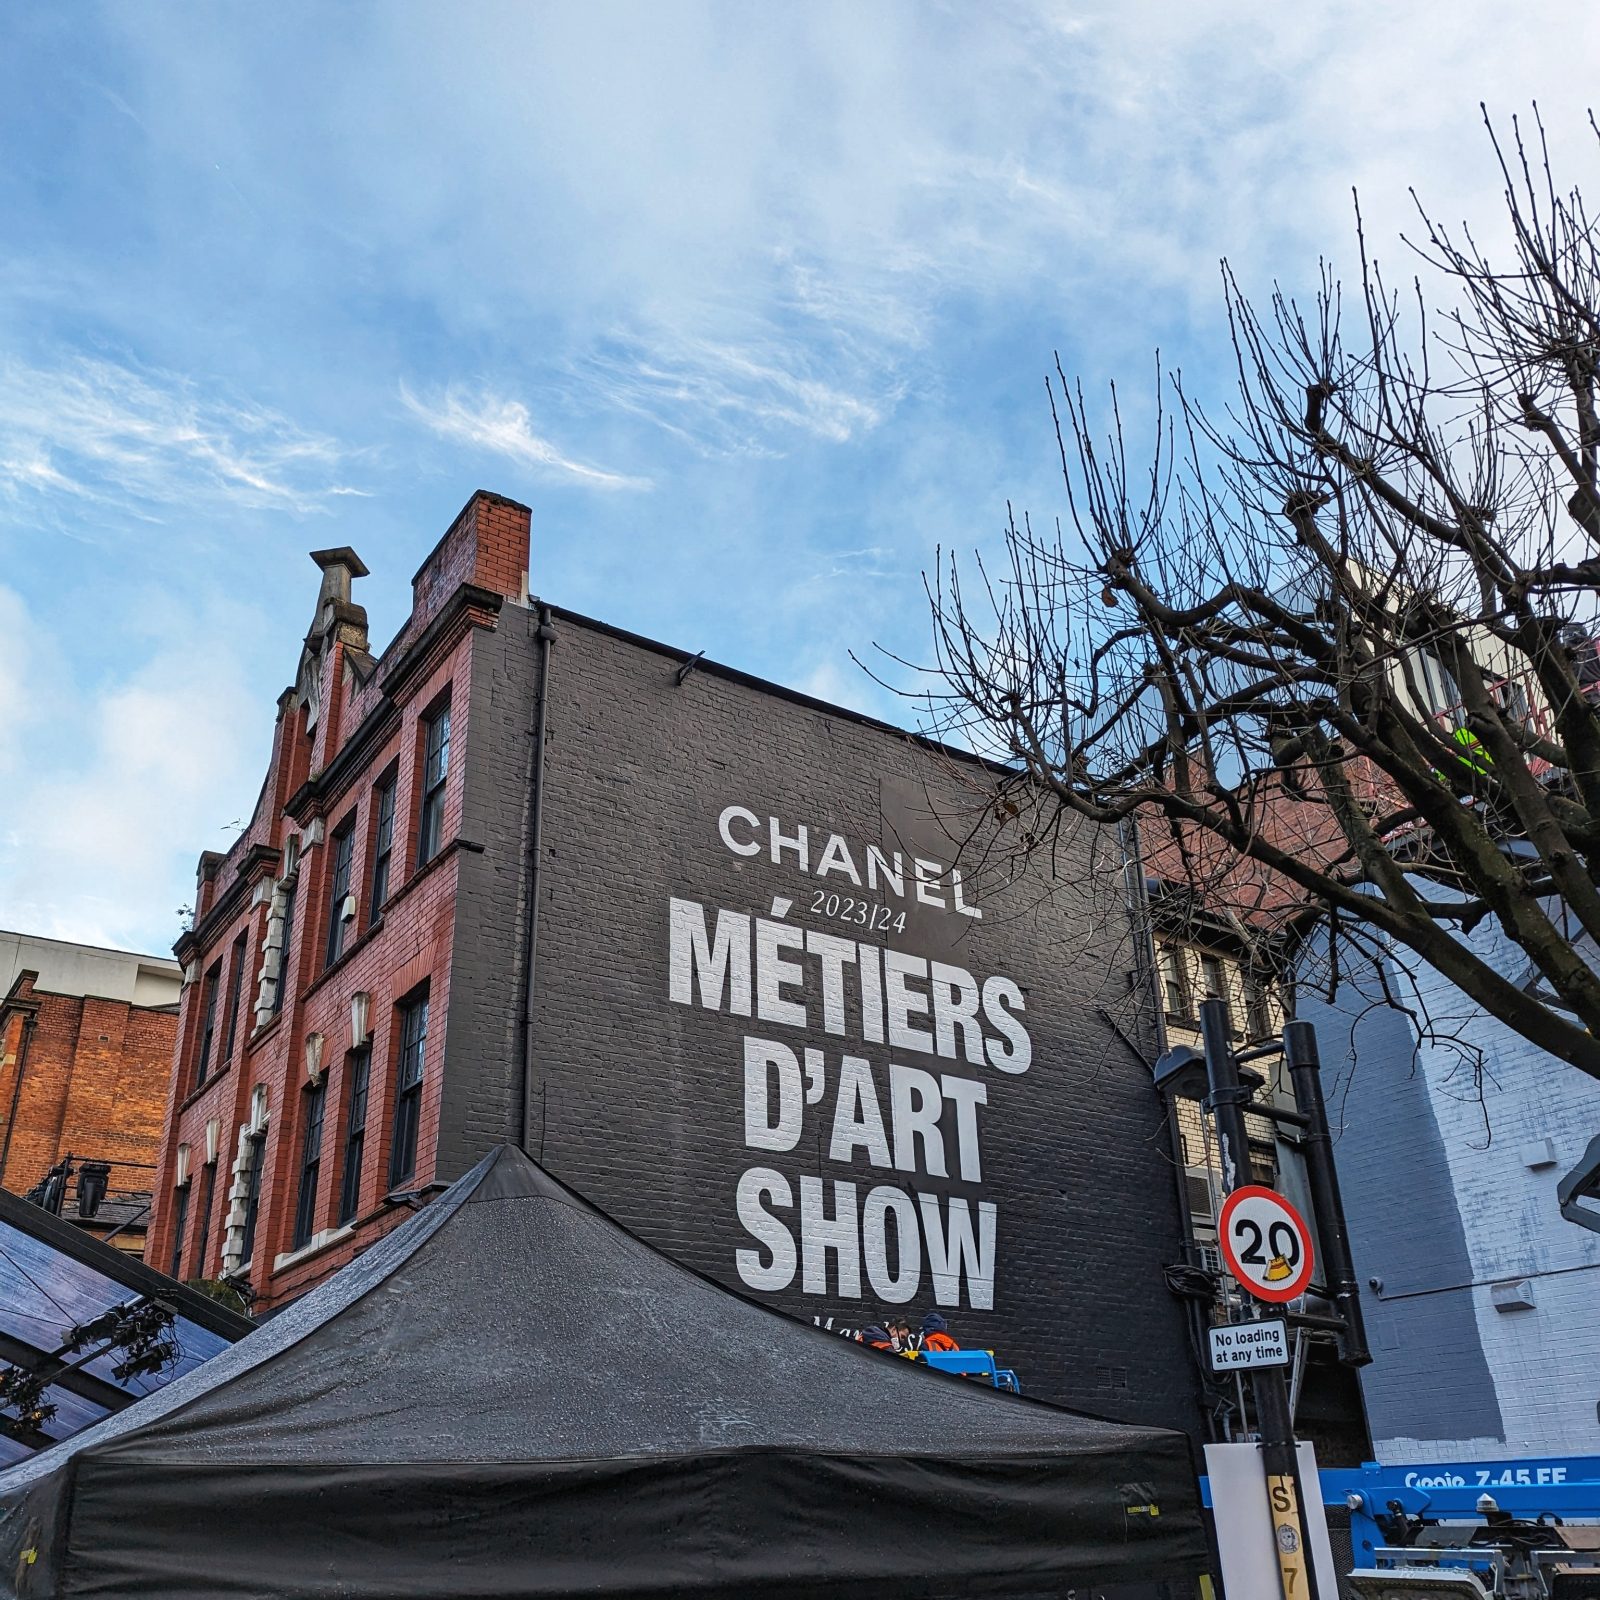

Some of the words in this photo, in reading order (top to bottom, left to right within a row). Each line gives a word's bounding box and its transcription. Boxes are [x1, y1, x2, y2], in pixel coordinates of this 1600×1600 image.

[718, 806, 982, 919] CHANEL
[811, 891, 906, 933] 2023/24
[669, 896, 1032, 1074] MÉTIERS
[744, 1035, 987, 1183] D'ART
[736, 1167, 997, 1310] SHOW
[1235, 1219, 1300, 1267] 20
[1215, 1333, 1232, 1346] No
[1235, 1329, 1280, 1344] loading
[1216, 1350, 1228, 1363] at
[1231, 1350, 1252, 1362] any
[1256, 1346, 1283, 1359] time
[1272, 1486, 1291, 1512] S
[1283, 1567, 1298, 1594] 7
